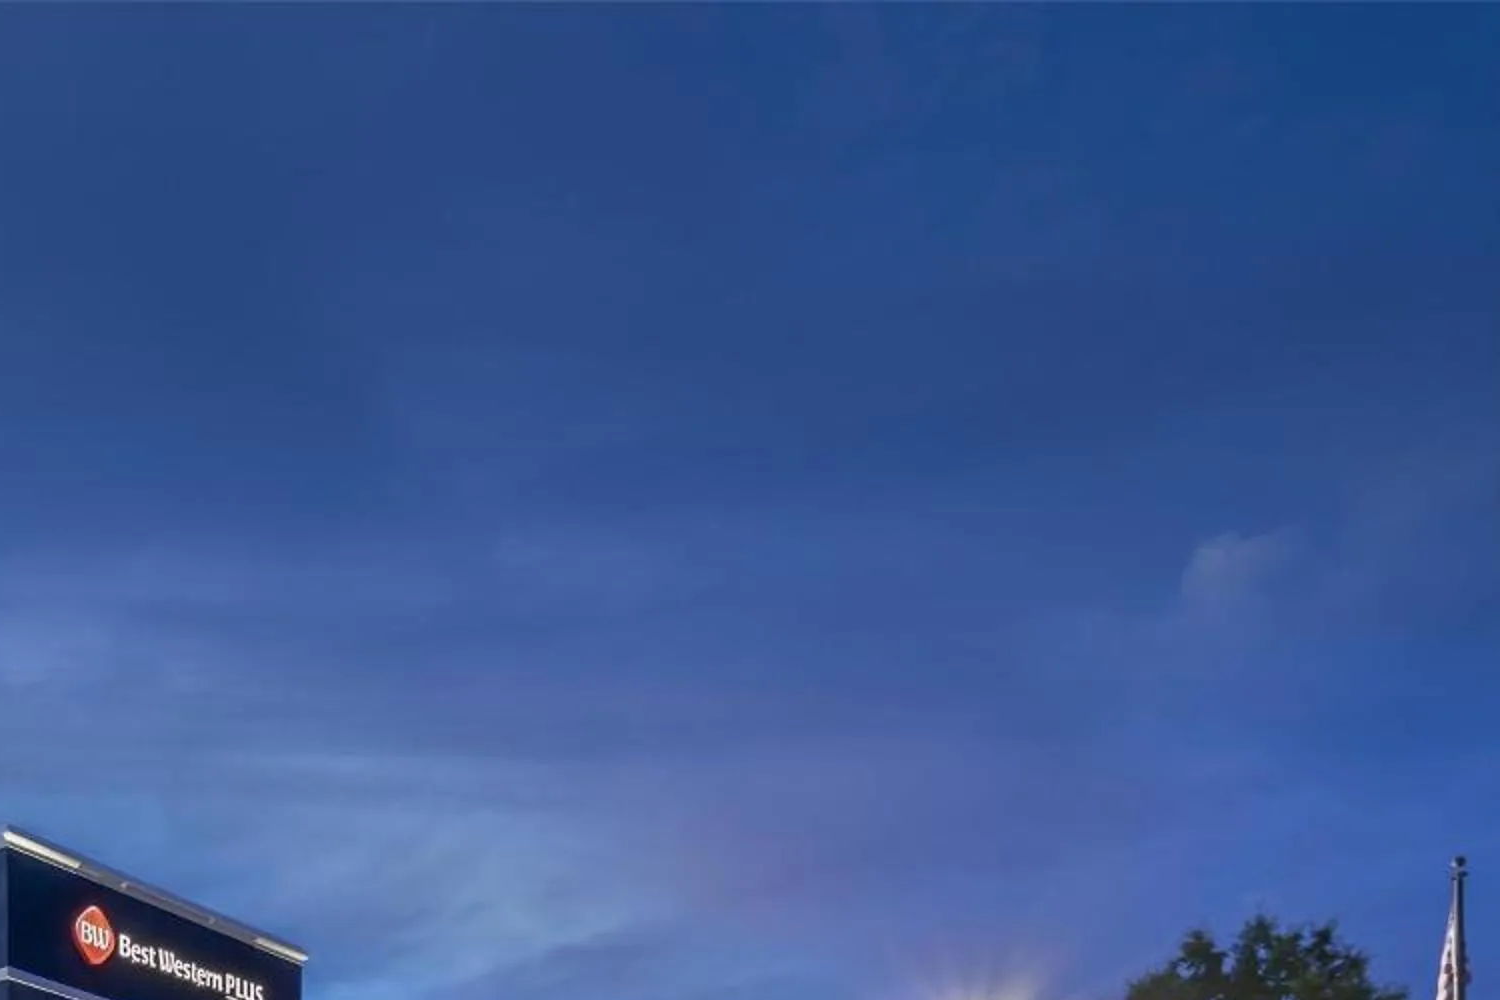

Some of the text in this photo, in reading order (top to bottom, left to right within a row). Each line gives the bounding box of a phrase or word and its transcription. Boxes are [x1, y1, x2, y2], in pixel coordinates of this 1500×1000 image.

[81, 921, 109, 949] BW
[119, 933, 157, 968] Best
[158, 948, 223, 992] Western
